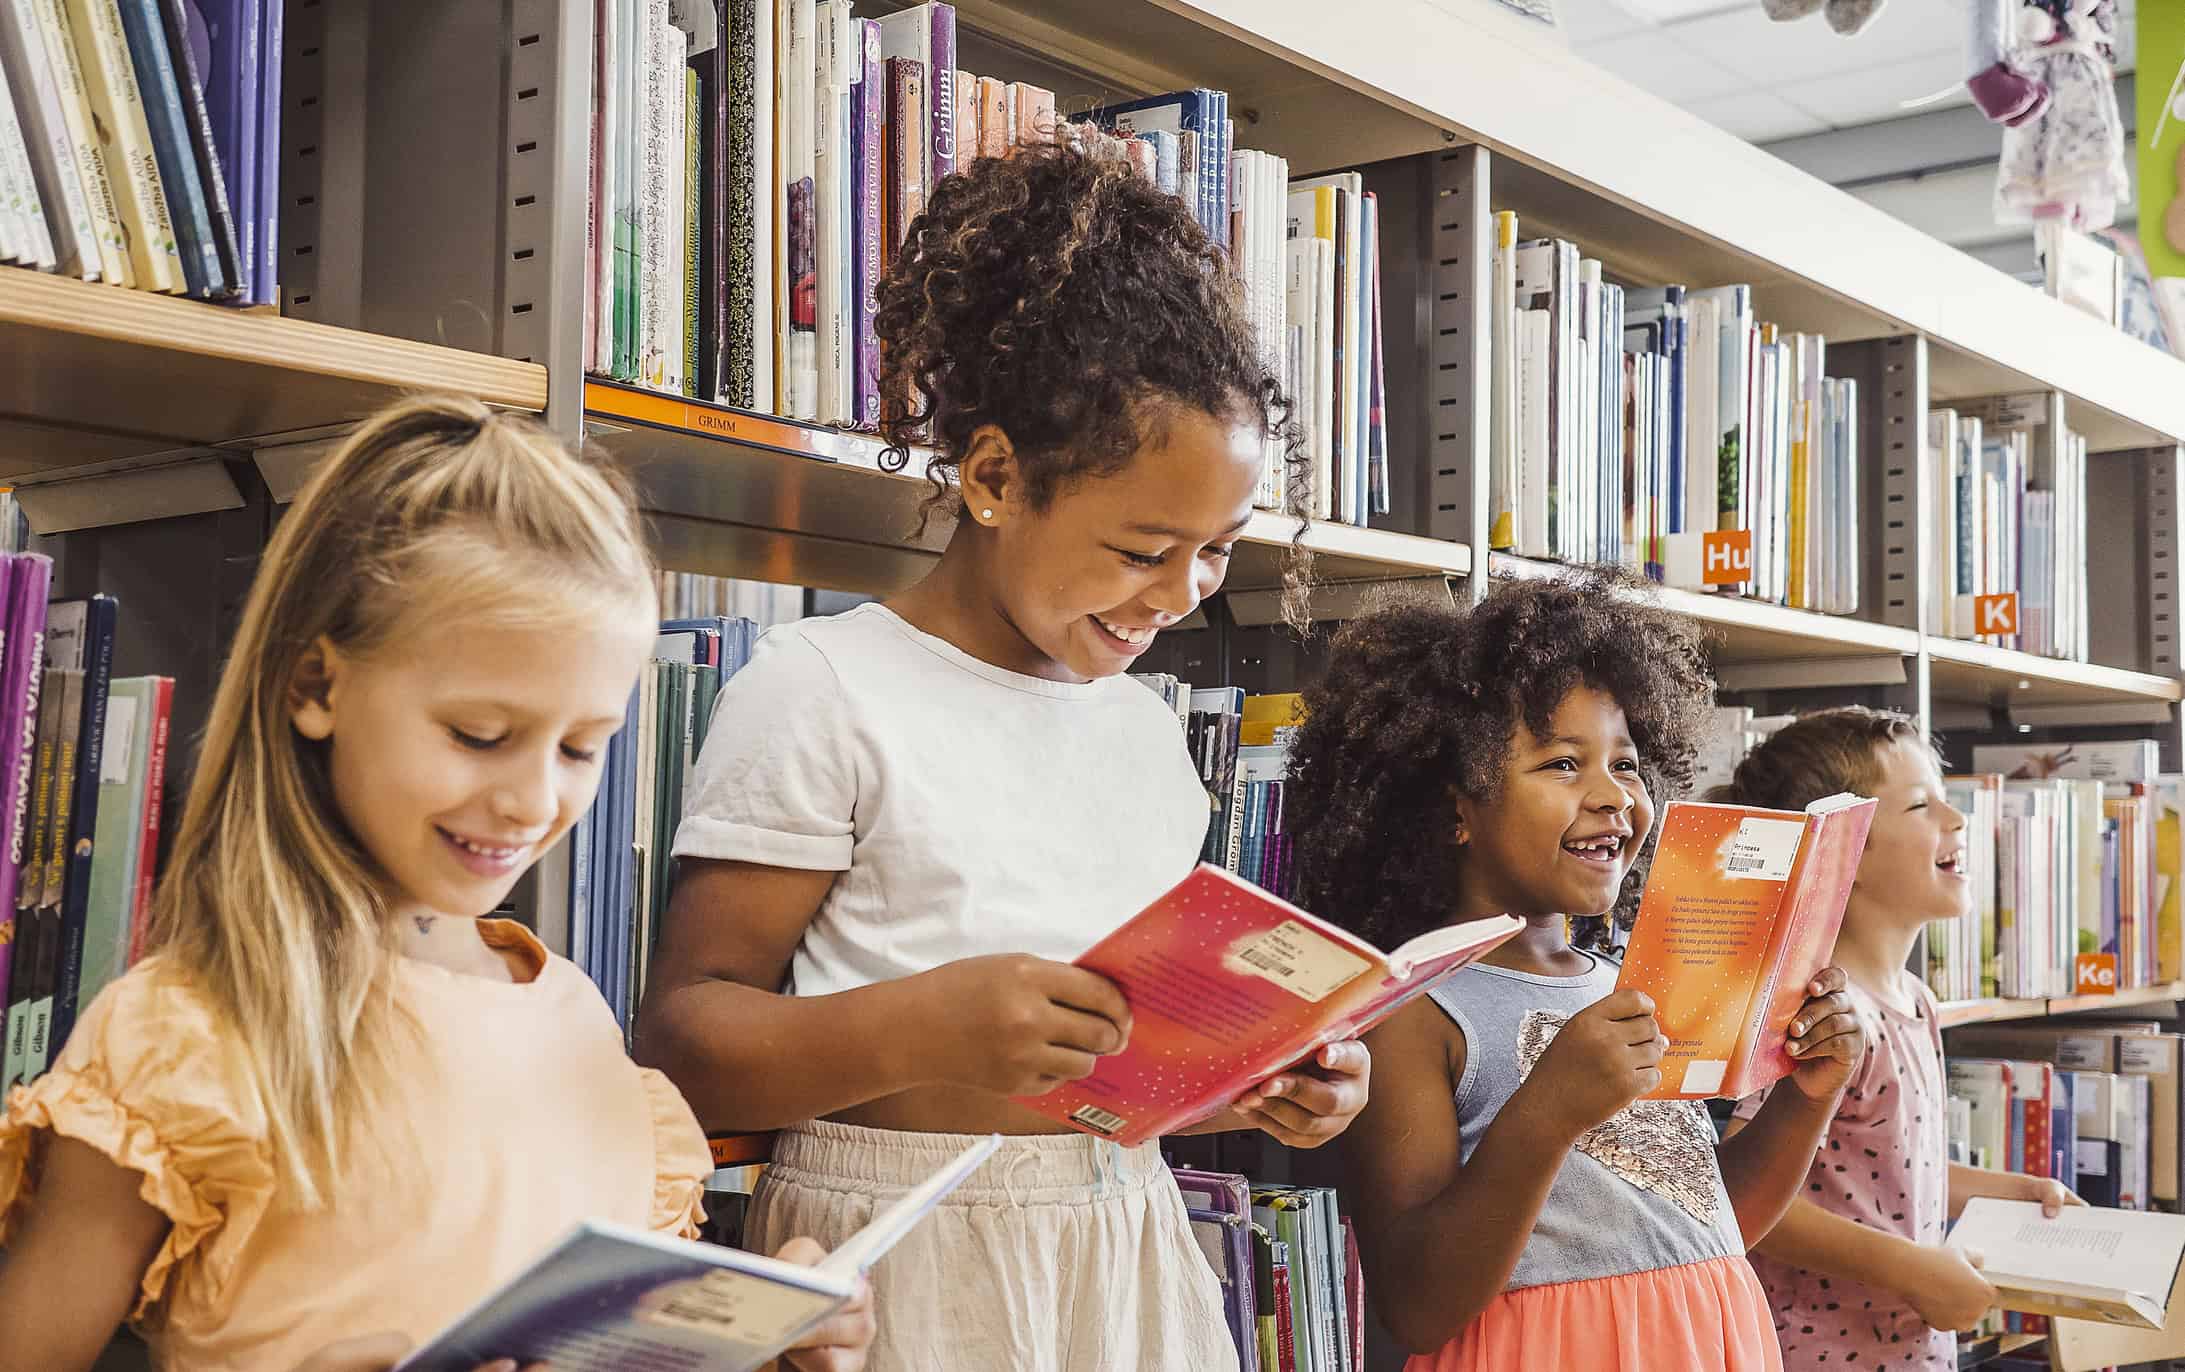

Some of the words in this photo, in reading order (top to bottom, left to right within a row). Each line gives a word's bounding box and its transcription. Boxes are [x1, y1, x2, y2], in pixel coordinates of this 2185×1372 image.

[934, 68, 955, 159] Grimm
[144, 154, 158, 182] AJDA
[153, 185, 170, 231] Založba
[686, 222, 696, 264] Grimm
[864, 228, 880, 314] GRIMMOVE
[686, 267, 696, 318] Wilhelm
[686, 332, 696, 367] Jacob
[698, 415, 737, 432] GRIMM
[1707, 542, 1751, 572] Hu
[1983, 598, 2012, 630] K
[24, 631, 44, 712] MINUTA
[22, 715, 37, 749] ZA
[1234, 779, 1248, 830] Bogdan
[1229, 836, 1241, 872] Grom
[2079, 962, 2114, 987] Ke
